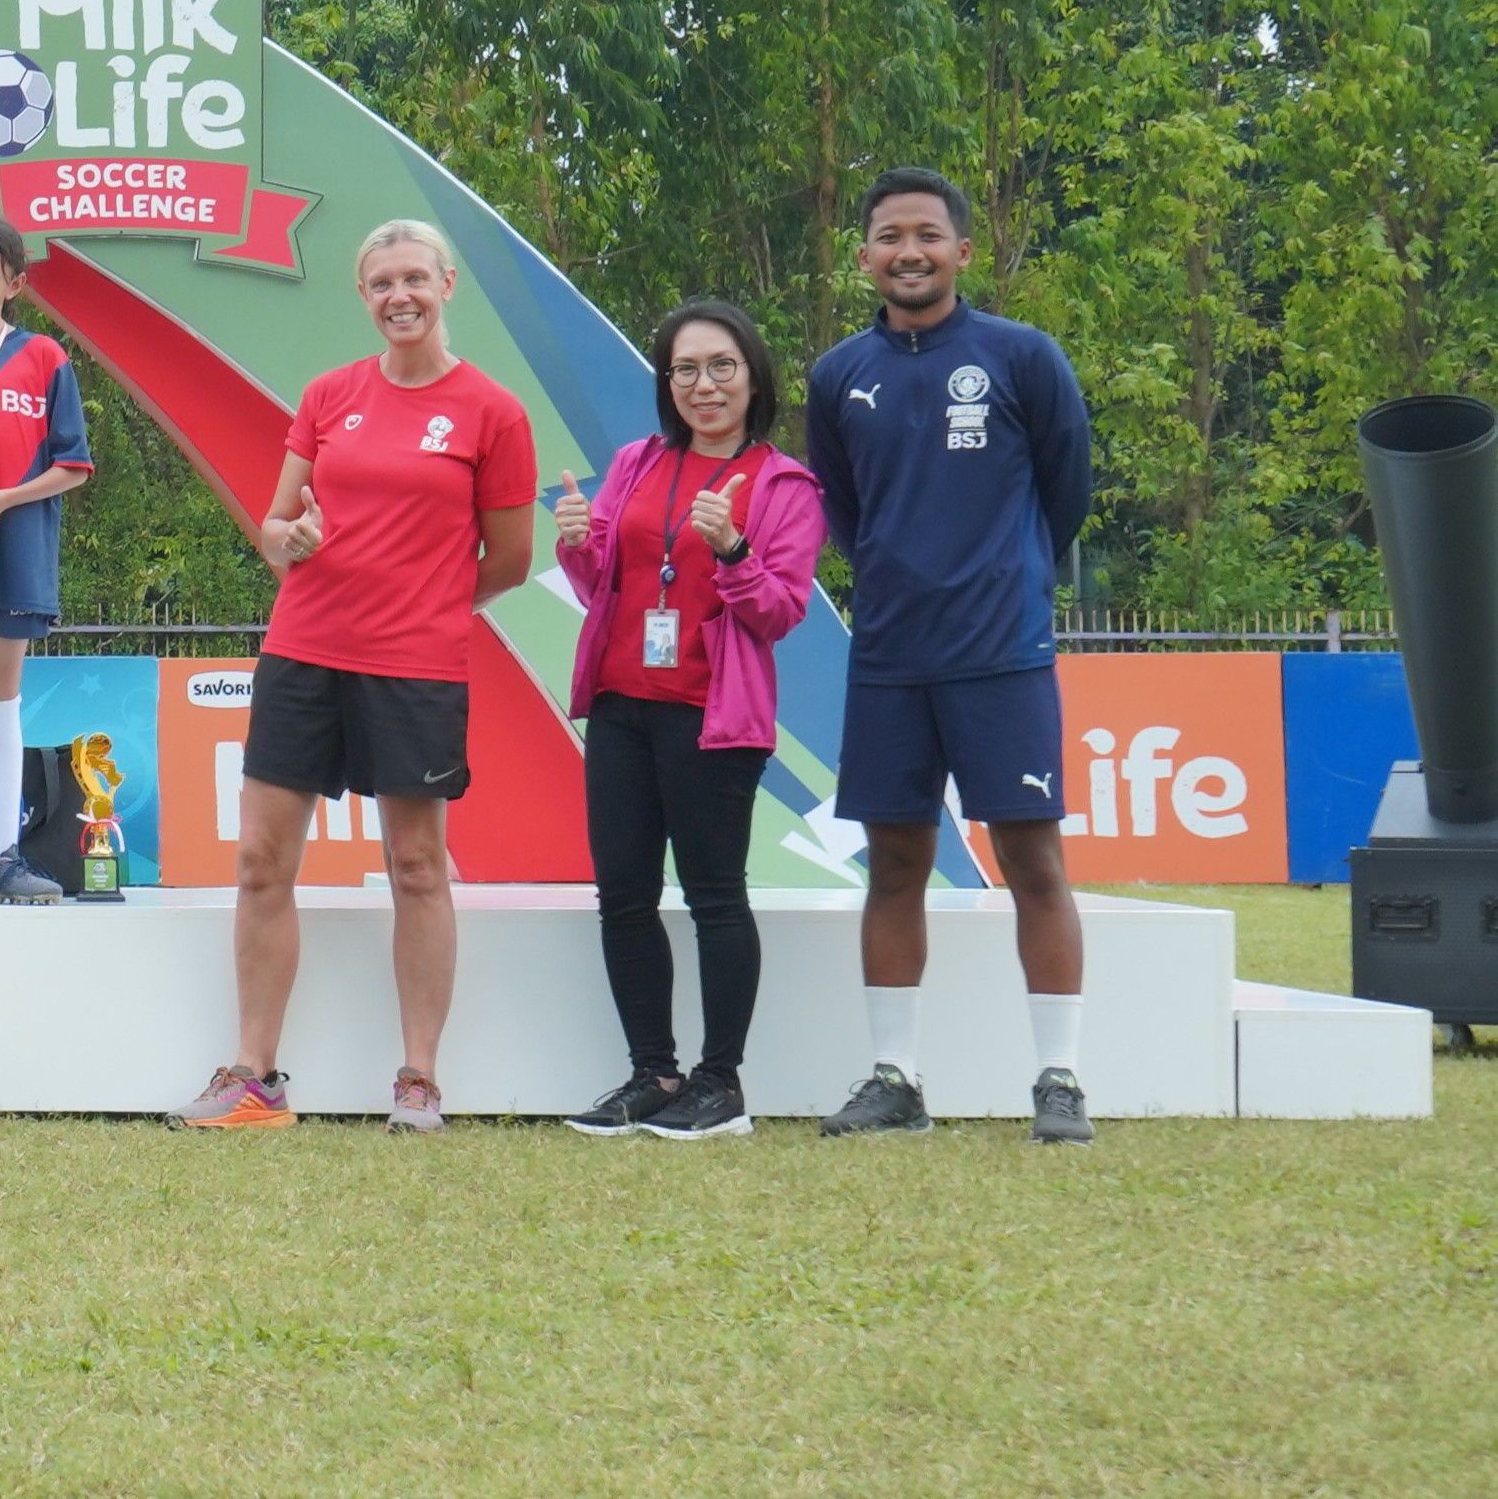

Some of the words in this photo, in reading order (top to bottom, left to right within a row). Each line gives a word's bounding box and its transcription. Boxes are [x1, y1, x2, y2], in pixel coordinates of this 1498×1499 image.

[55, 54, 246, 150] Life
[56, 163, 187, 190] SOCCER
[29, 194, 217, 223] CHALLENGE
[1, 389, 47, 419] BSJ
[947, 431, 988, 451] BSJ
